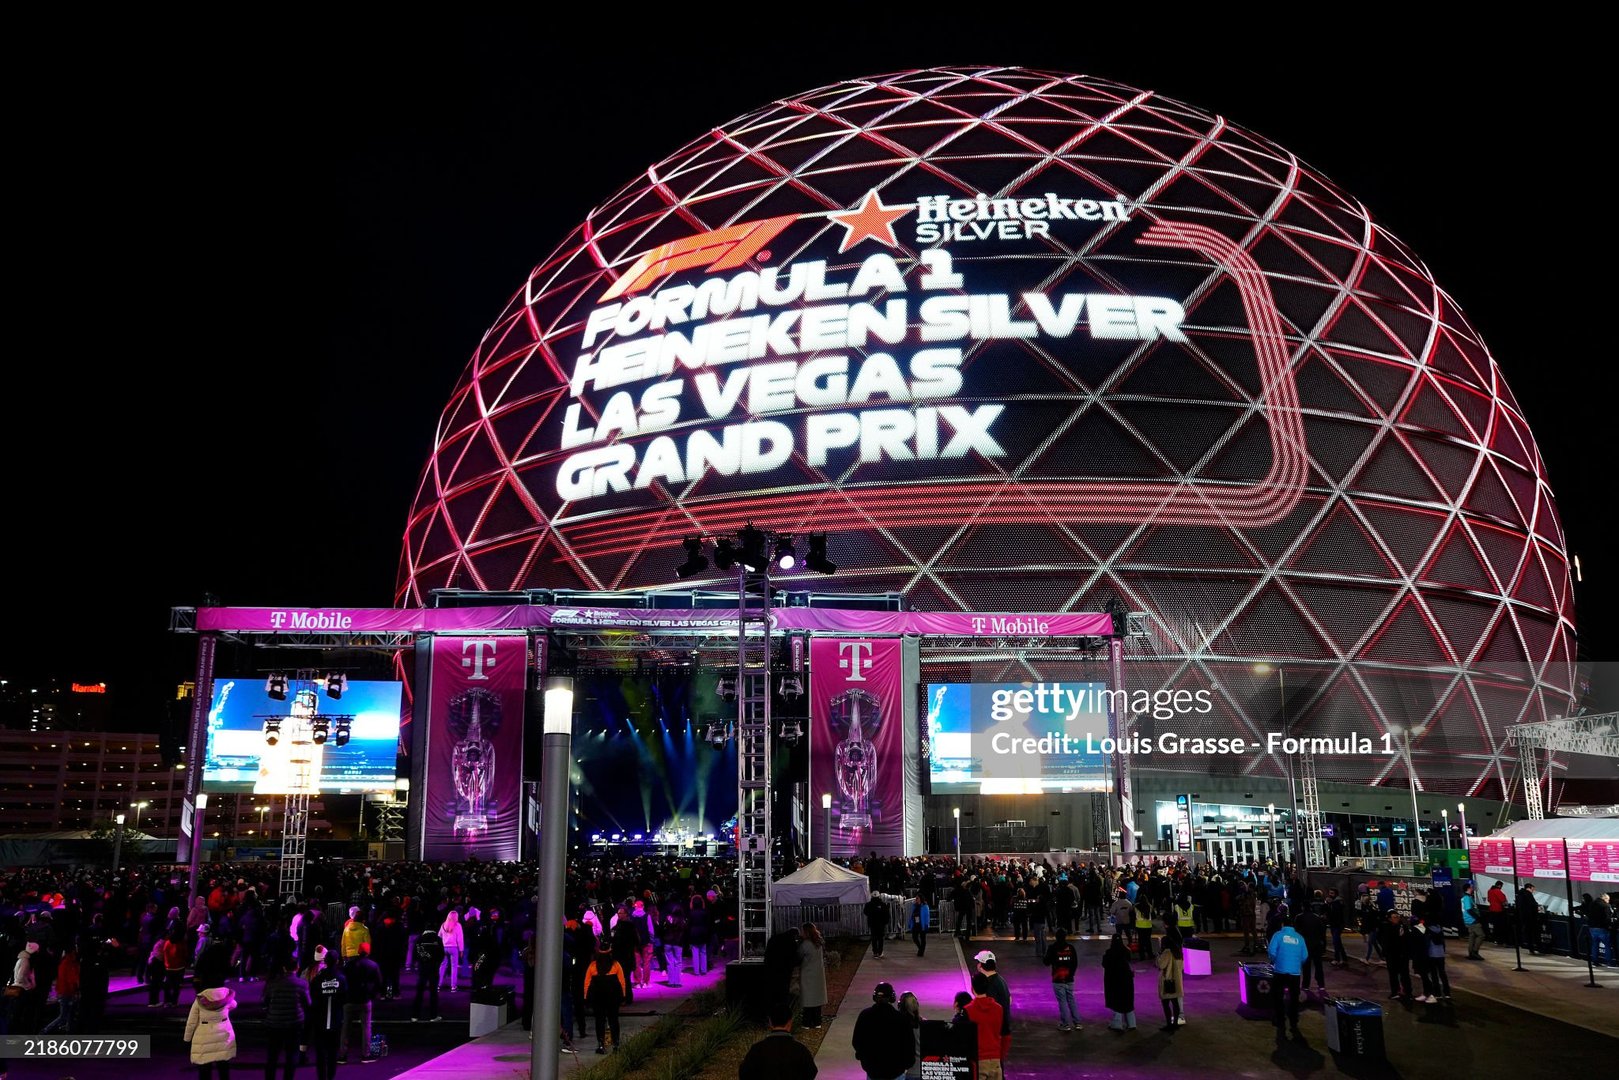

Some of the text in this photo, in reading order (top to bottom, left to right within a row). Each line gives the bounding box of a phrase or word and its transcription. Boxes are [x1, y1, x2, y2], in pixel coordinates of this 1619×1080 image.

[915, 193, 1129, 222] Heineken
[915, 219, 1050, 244] SILVER
[582, 249, 963, 350] FORMULA 1
[570, 293, 1188, 397] HEINEKEN SILVER
[561, 347, 964, 450] LAS VEGAS
[555, 404, 1006, 501] GRAND PRIX
[289, 611, 352, 630] Mobile
[550, 617, 592, 625] FORMULA
[990, 616, 1049, 635] Mobile
[1354, 1020, 1364, 1054] recycle.
